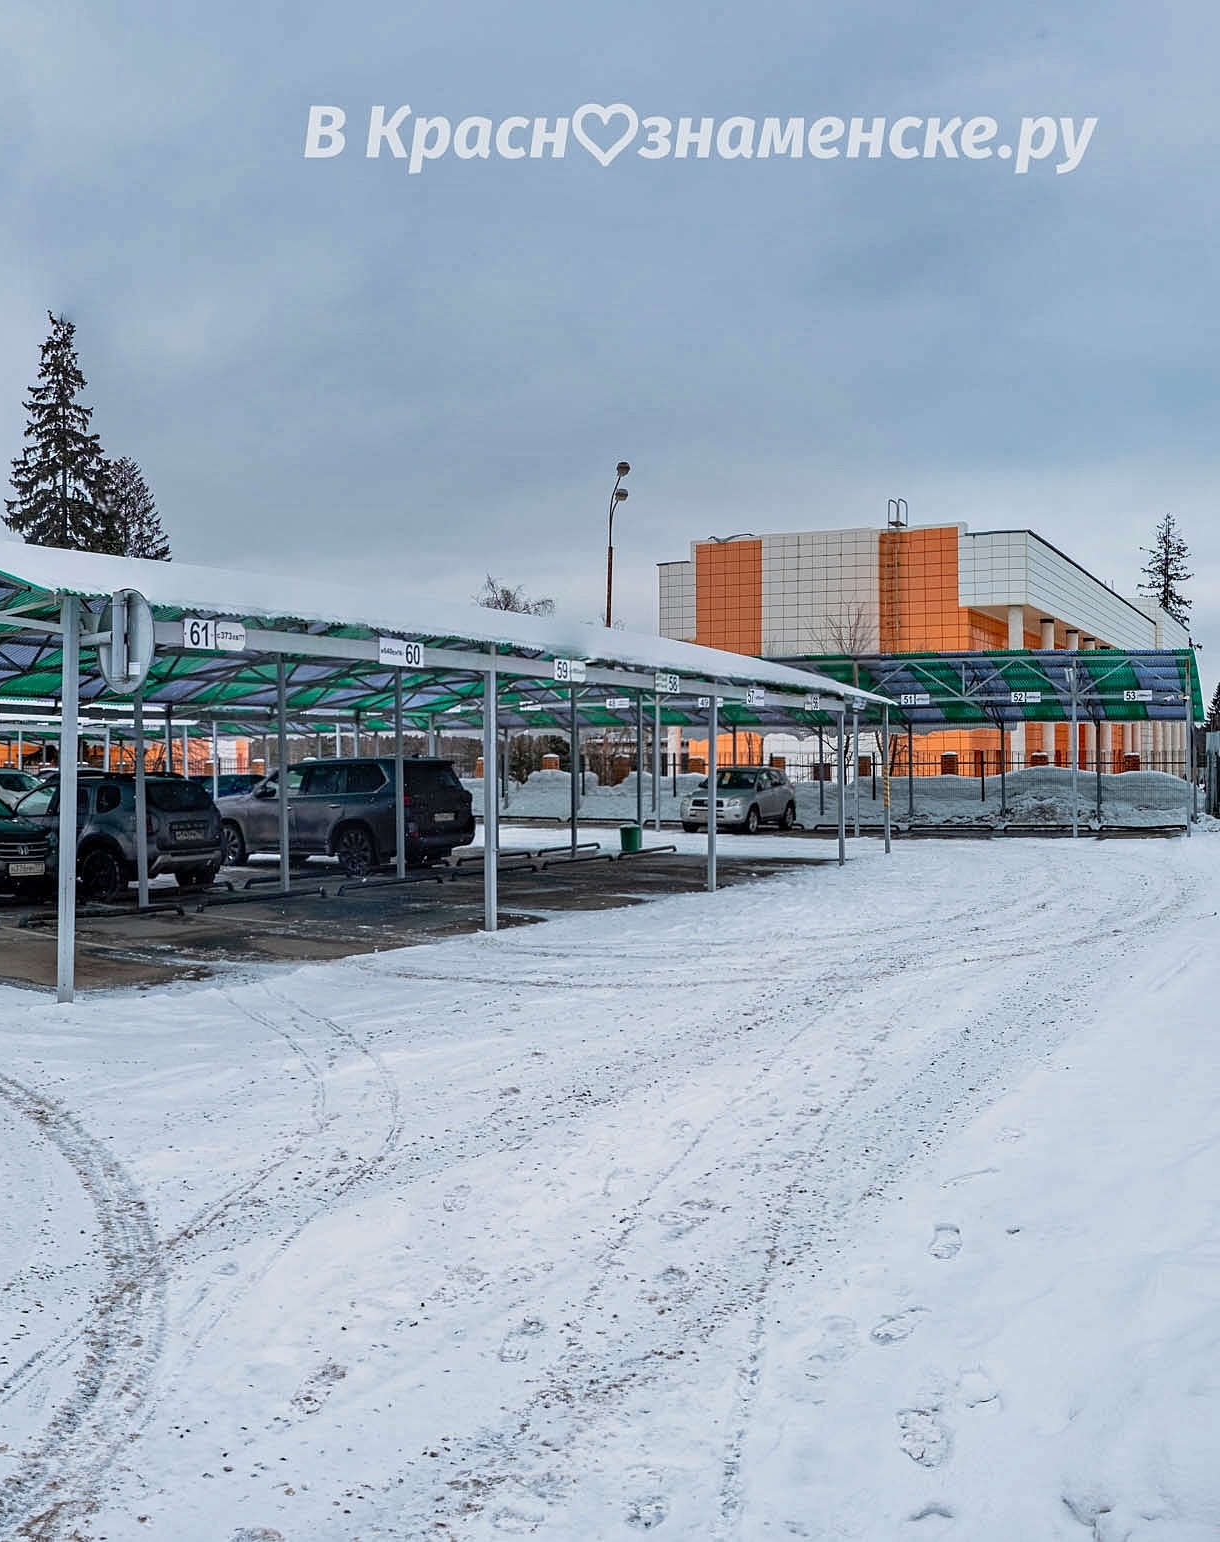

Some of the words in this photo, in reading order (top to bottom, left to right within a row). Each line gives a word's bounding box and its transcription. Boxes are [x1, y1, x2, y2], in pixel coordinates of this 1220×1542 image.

[189, 621, 209, 647] 61
[405, 643, 420, 665] 60
[556, 661, 568, 679] 59
[668, 675, 678, 692] 58
[746, 690, 755, 704] 57
[903, 695, 913, 705] 51
[1013, 692, 1024, 702] 52
[1125, 691, 1136, 701] 53
